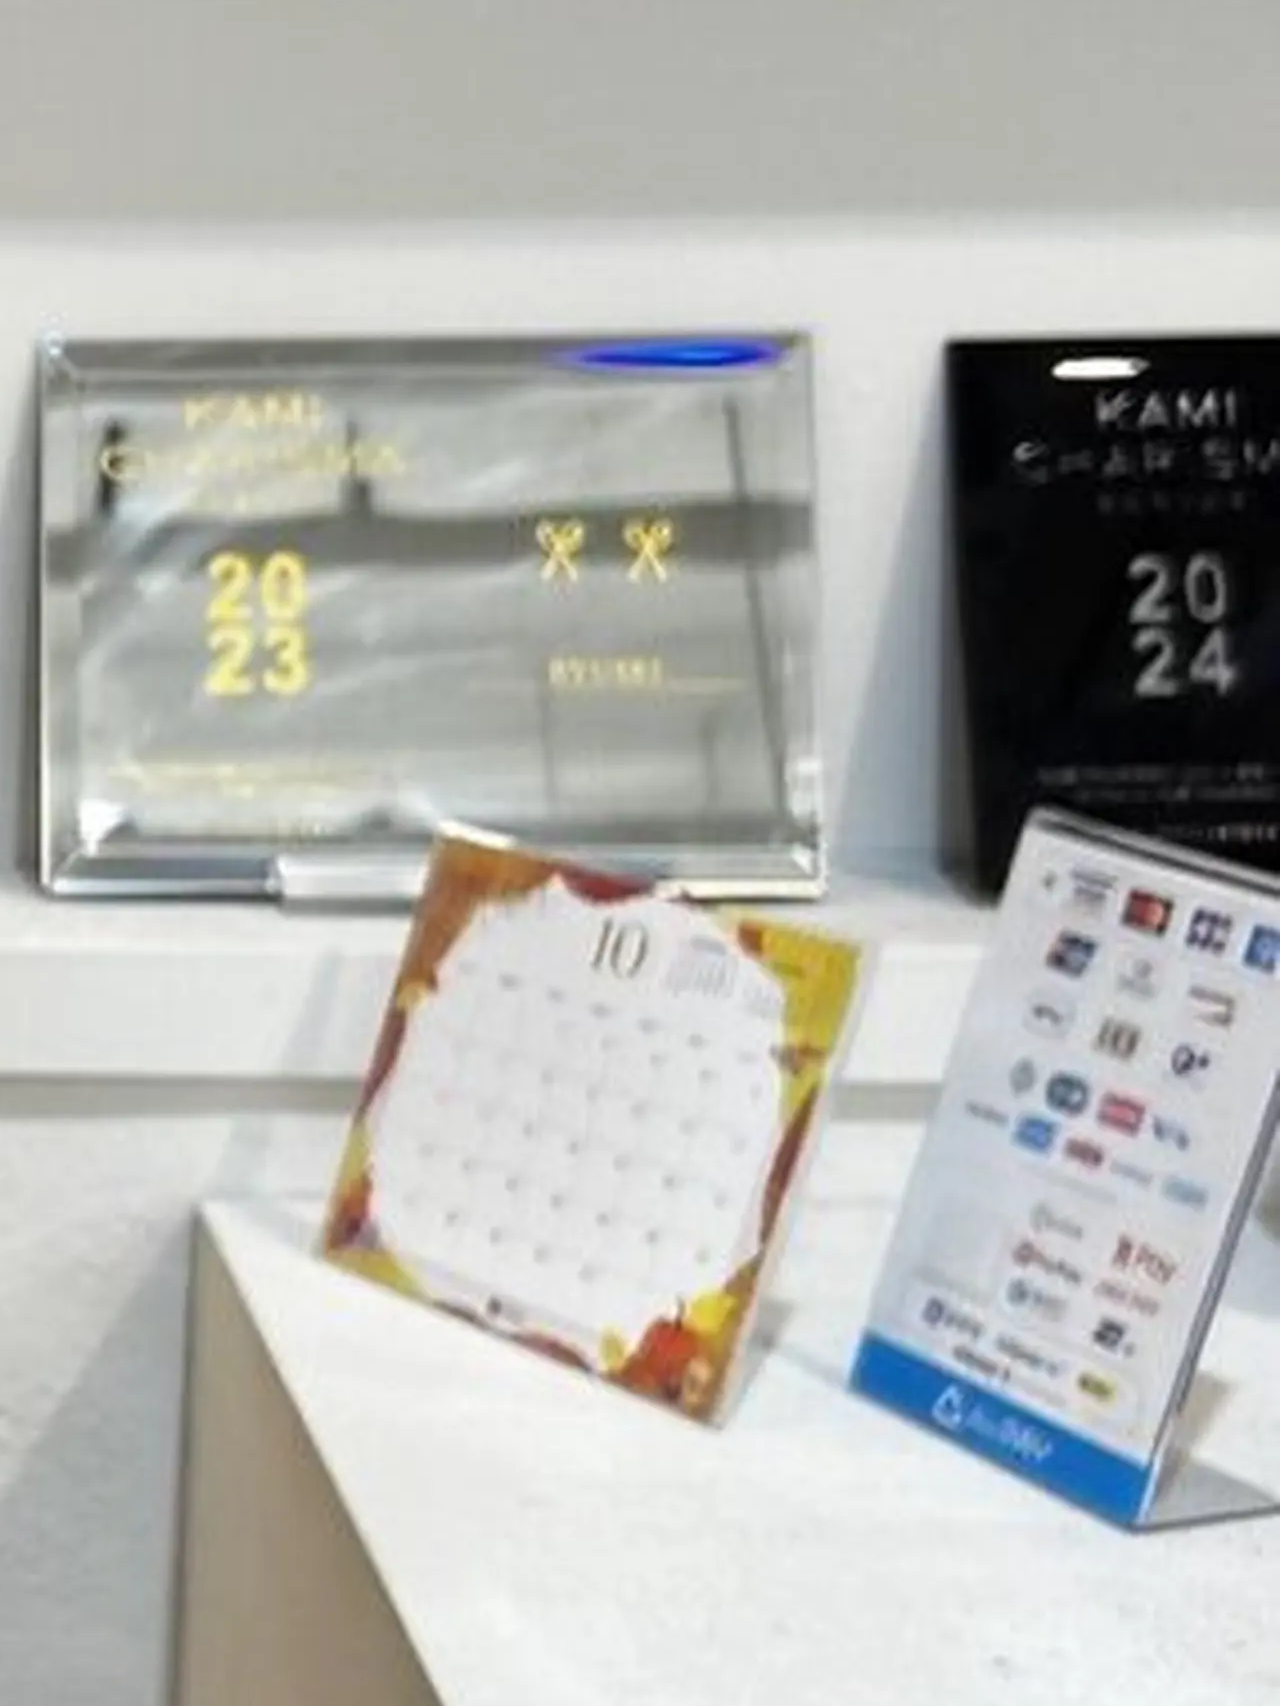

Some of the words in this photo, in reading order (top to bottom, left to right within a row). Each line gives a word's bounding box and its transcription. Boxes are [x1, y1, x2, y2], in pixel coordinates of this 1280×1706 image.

[1095, 389, 1237, 430] KAMI
[207, 552, 306, 620] 20
[1127, 553, 1228, 624] 20
[205, 625, 308, 696] 23
[1132, 627, 1236, 695] 24
